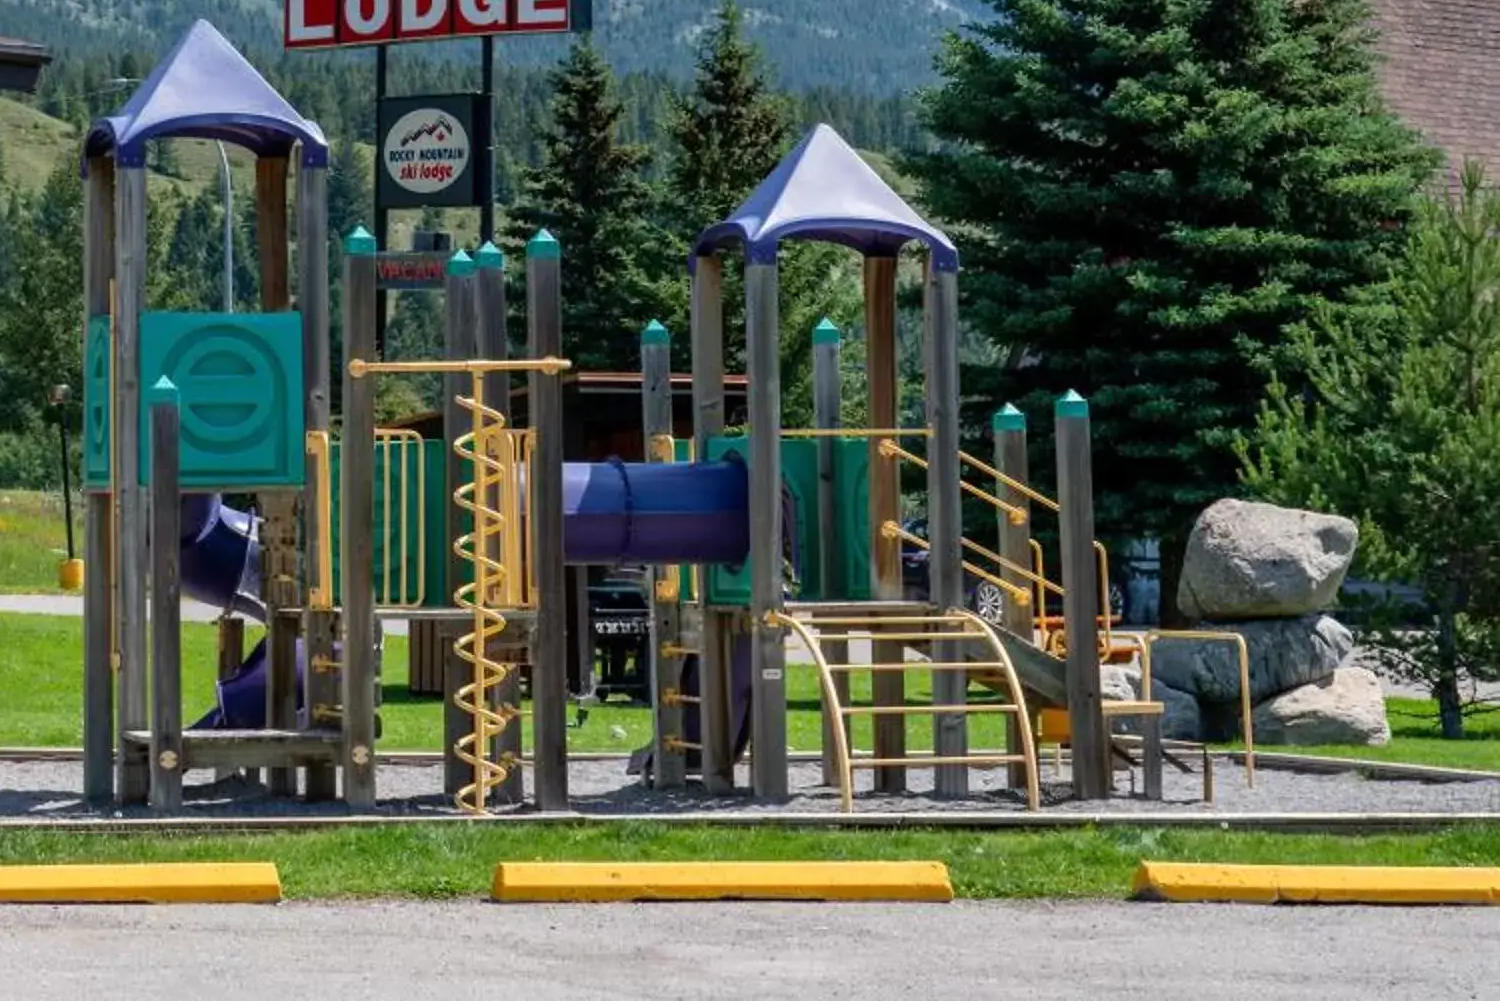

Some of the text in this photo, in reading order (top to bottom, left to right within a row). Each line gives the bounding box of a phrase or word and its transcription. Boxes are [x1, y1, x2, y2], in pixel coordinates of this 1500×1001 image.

[389, 148, 465, 162] ROCKY MOUNTAIN
[400, 162, 453, 182] ski lodge
[377, 260, 443, 279] VACAN
